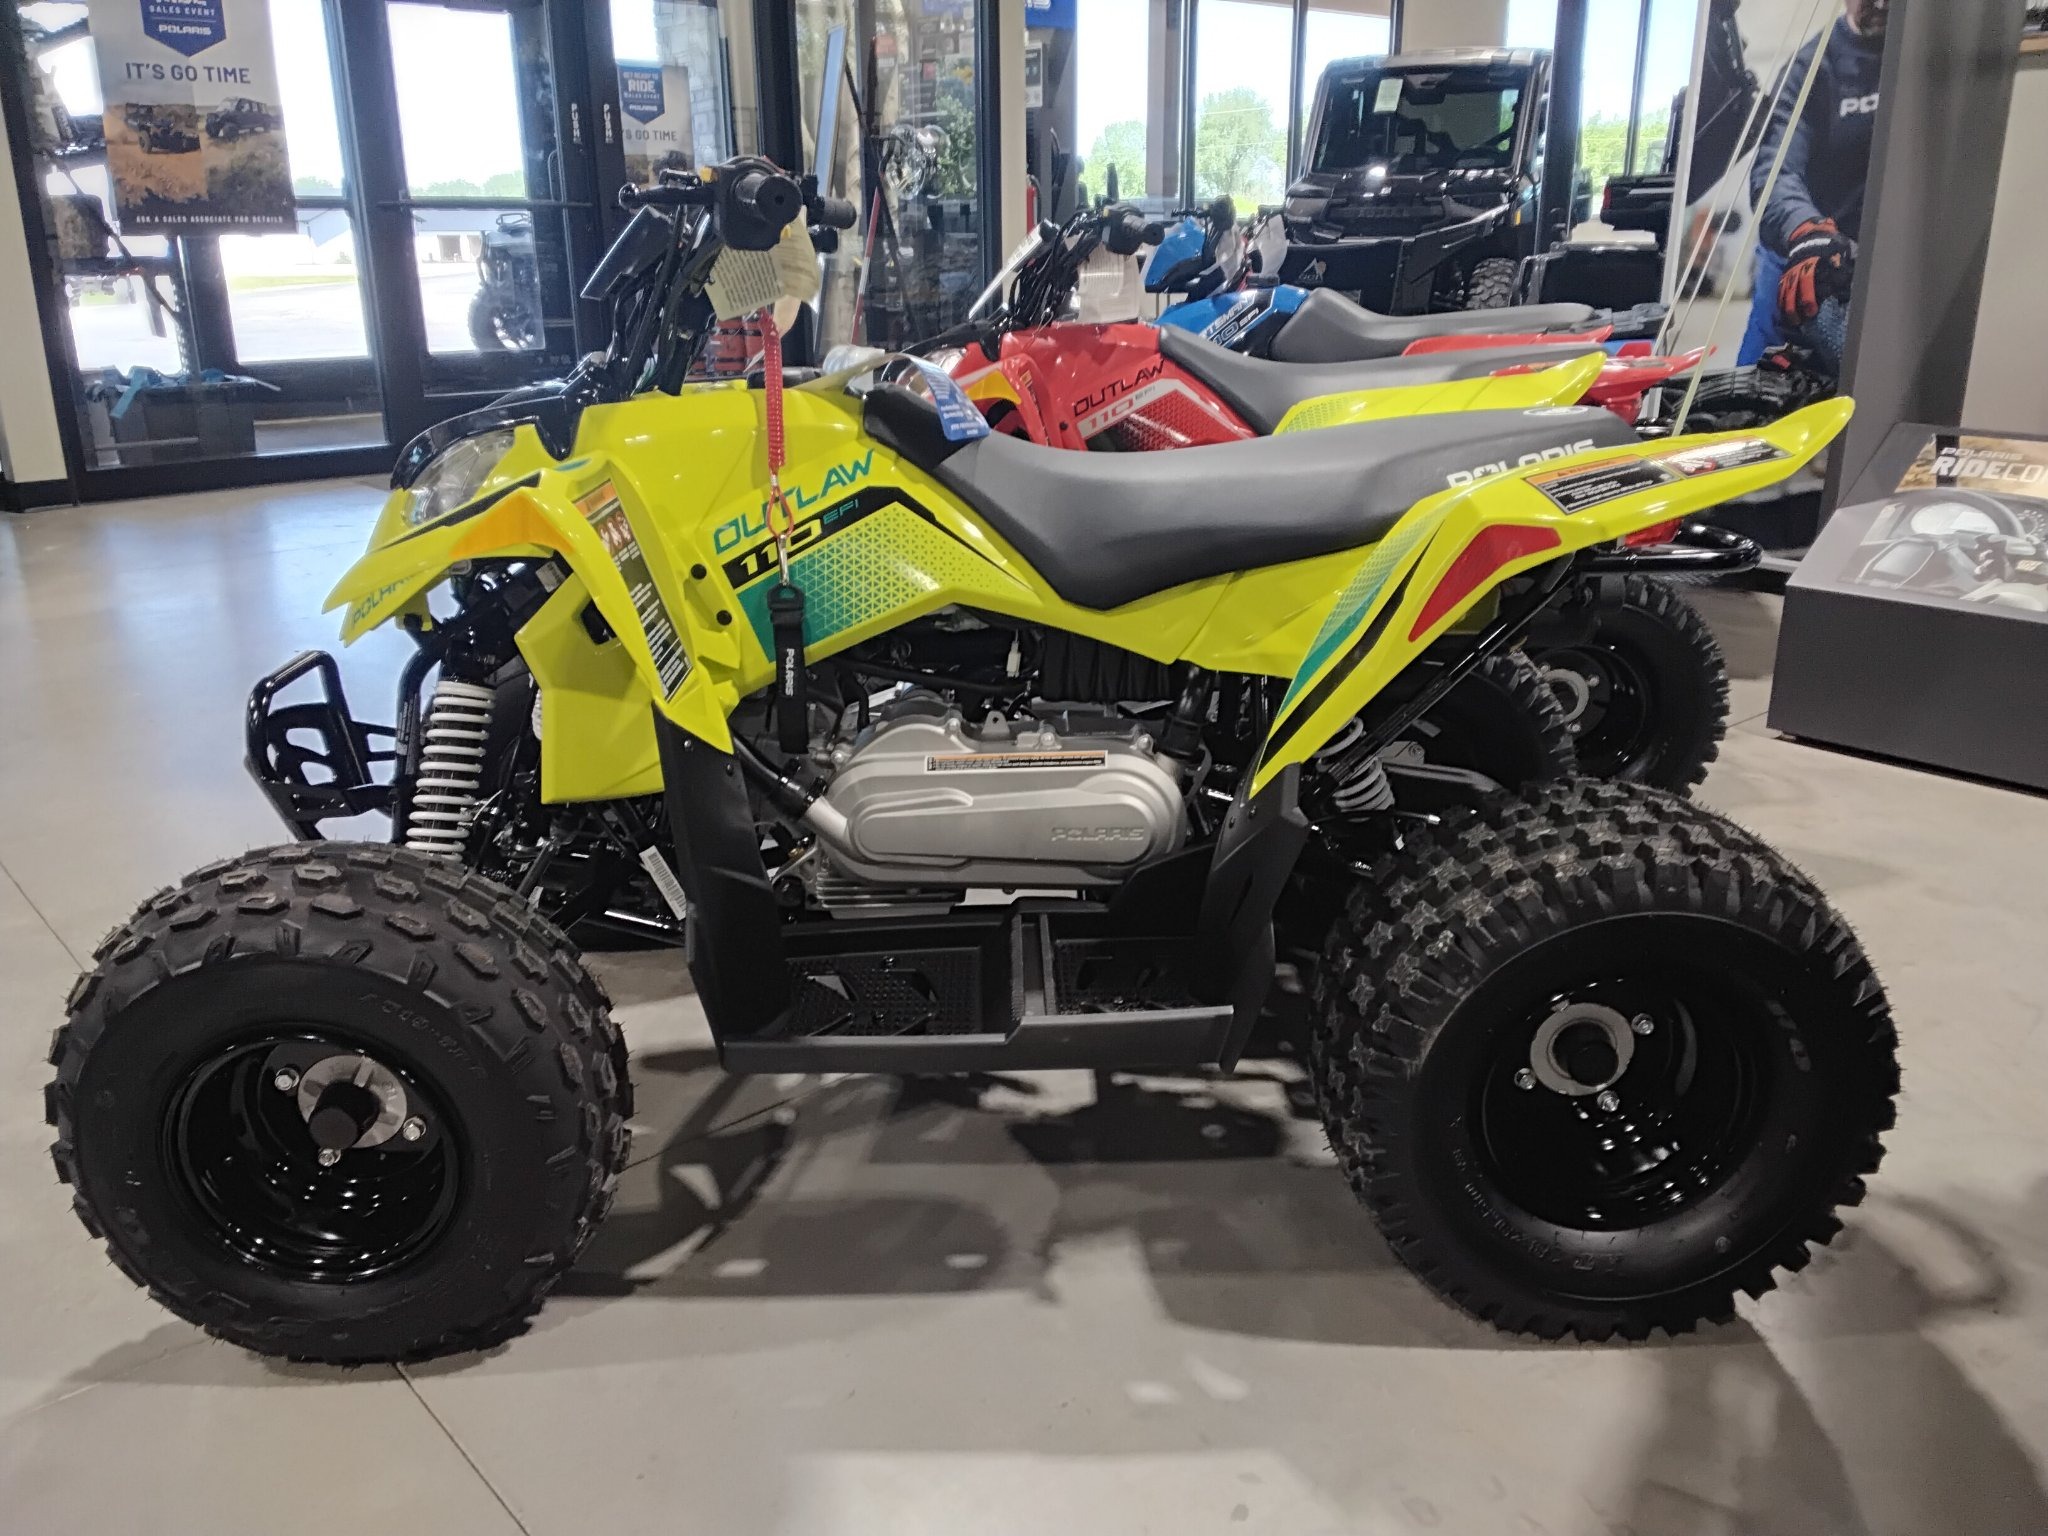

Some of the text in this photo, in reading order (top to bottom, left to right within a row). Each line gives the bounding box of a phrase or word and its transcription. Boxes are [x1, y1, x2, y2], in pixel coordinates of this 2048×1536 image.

[149, 5, 215, 16] SALES EVENT
[158, 24, 212, 35] POLARIS
[125, 62, 251, 84] IT'S GO TIME
[571, 103, 580, 138] PUSH
[603, 103, 612, 138] PUSH
[653, 131, 677, 141] TIME
[1073, 358, 1166, 417] OUTLAW
[1089, 397, 1134, 429] 110
[1940, 447, 2024, 461] POLARIS
[1930, 455, 2048, 484] RIDECO
[713, 448, 874, 556] OUTLAW
[822, 498, 859, 525] EFI
[785, 648, 795, 696] POLARIS
